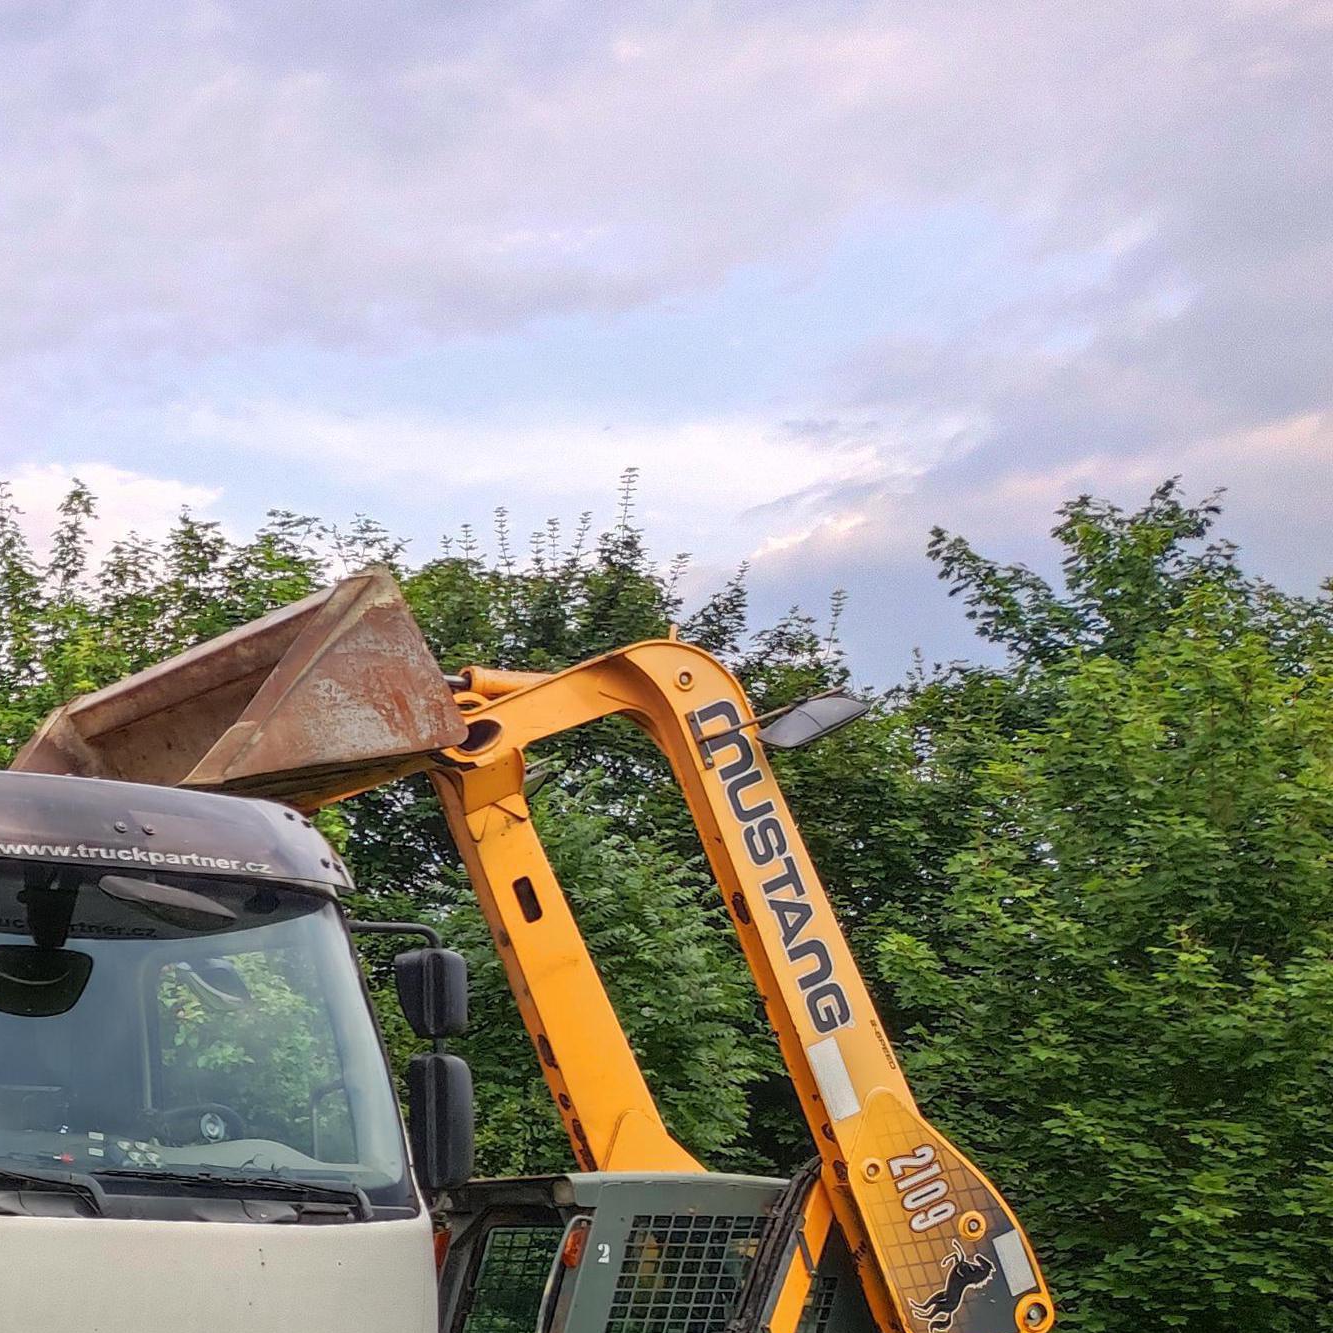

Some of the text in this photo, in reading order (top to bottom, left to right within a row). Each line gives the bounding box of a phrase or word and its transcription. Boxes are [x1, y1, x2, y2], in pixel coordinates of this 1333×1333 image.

[696, 700, 851, 1035] MUSTANG
[887, 1144, 956, 1233] 2109
[597, 1243, 611, 1264] 2
